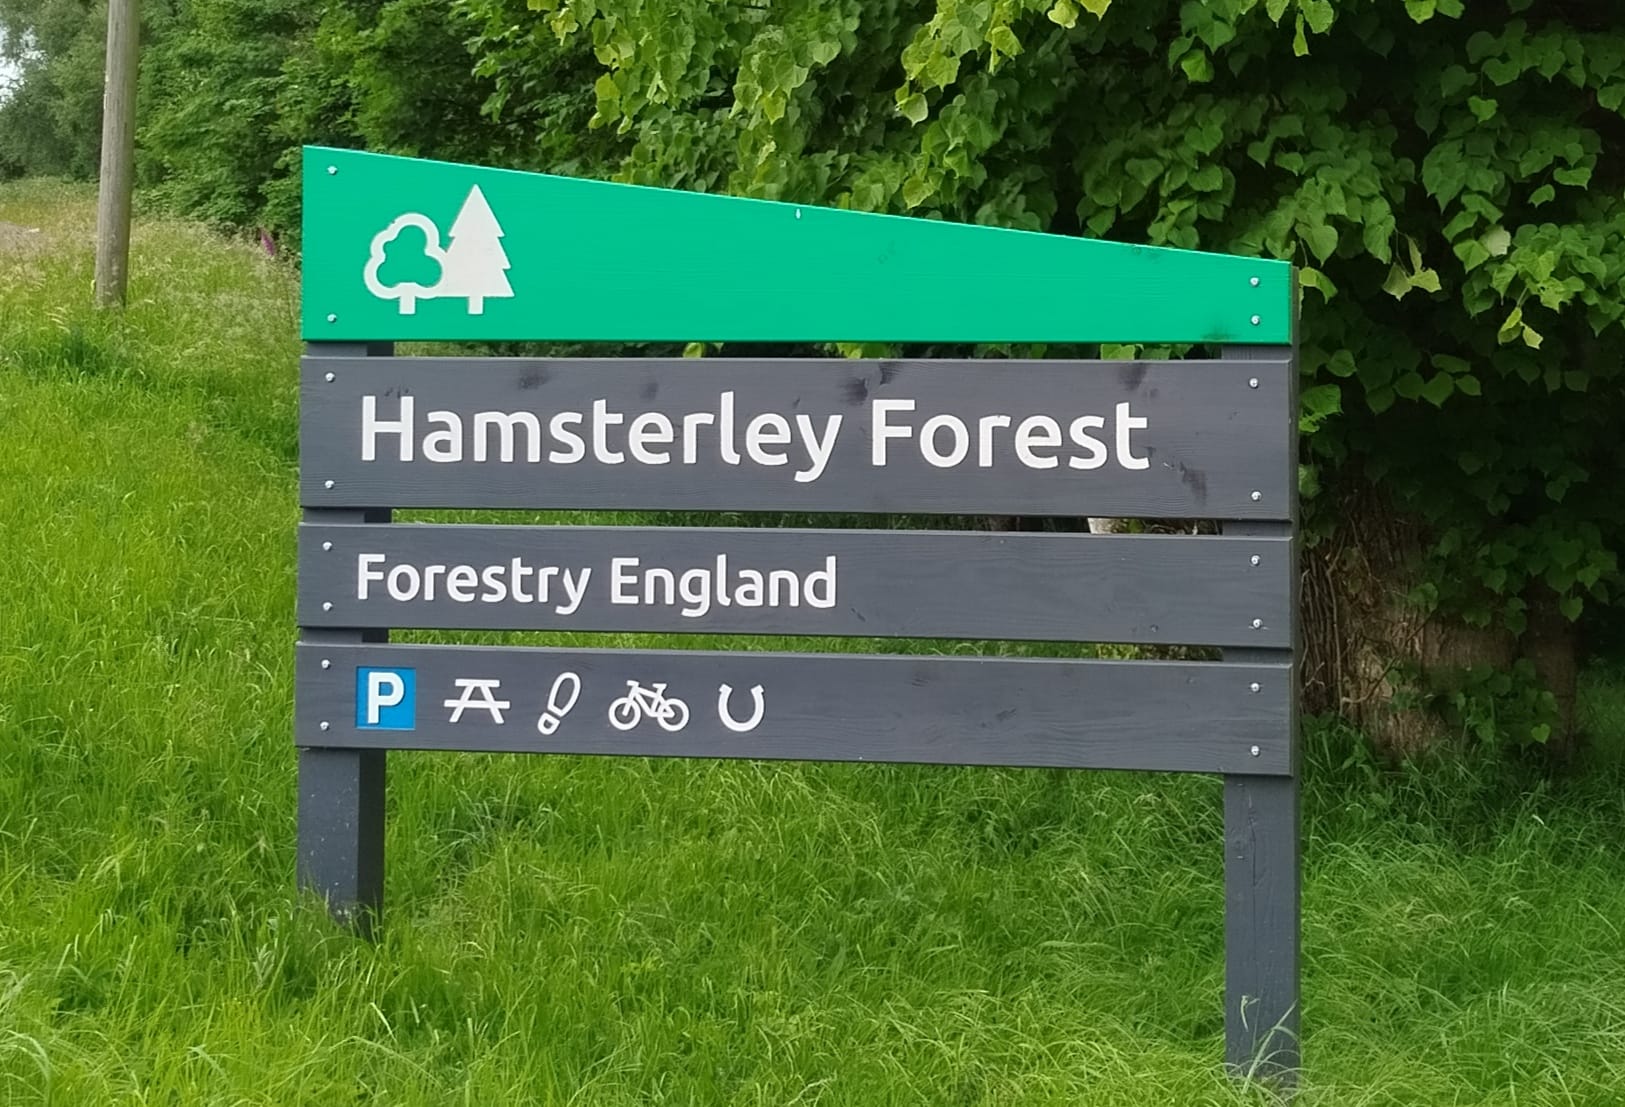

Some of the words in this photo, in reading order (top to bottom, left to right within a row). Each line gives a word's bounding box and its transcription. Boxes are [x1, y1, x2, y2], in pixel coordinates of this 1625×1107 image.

[361, 390, 843, 483] Hamsterley
[871, 398, 1150, 470] Forest
[357, 553, 592, 615] Forestry
[610, 553, 837, 618] England
[367, 671, 404, 724] P
